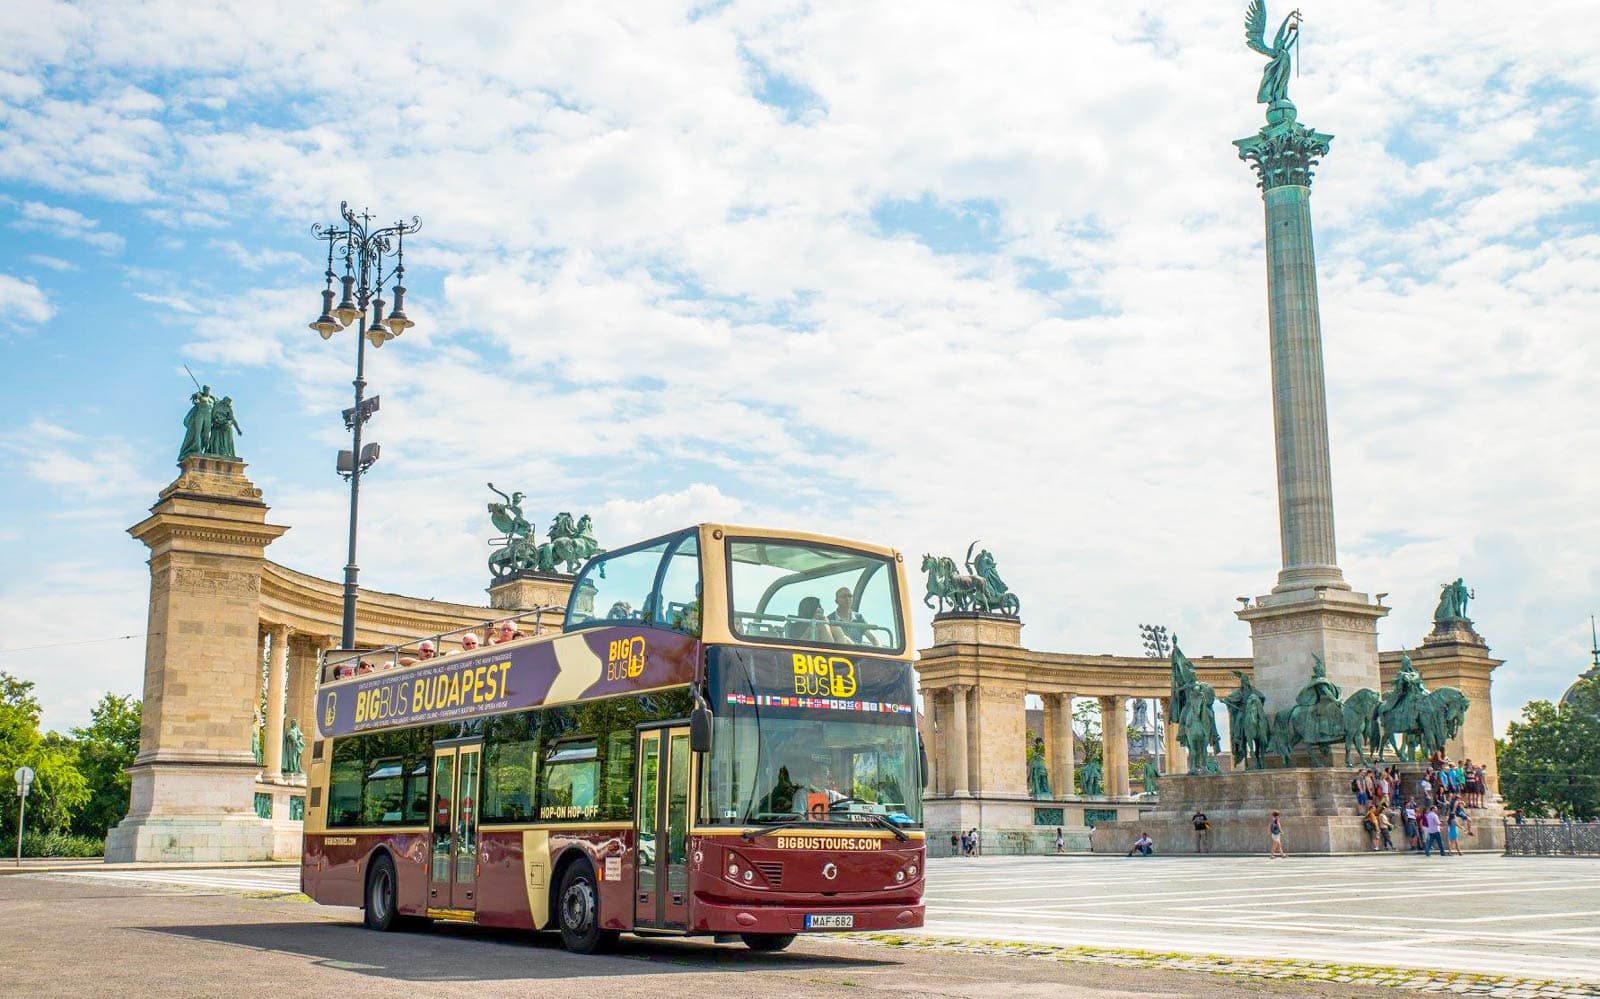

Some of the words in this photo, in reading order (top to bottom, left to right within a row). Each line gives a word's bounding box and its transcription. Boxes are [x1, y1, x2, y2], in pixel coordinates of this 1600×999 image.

[609, 638, 630, 661] BIG
[607, 660, 628, 681] BUS
[792, 653, 828, 675] BIG
[412, 661, 512, 713] BUDAPEST
[795, 675, 830, 696] BUS
[540, 806, 566, 819] HOP-ON
[567, 805, 599, 818] HOP-OFF
[777, 836, 881, 850] BIGBUSTOURS.COM
[812, 915, 852, 927] MAF-682
